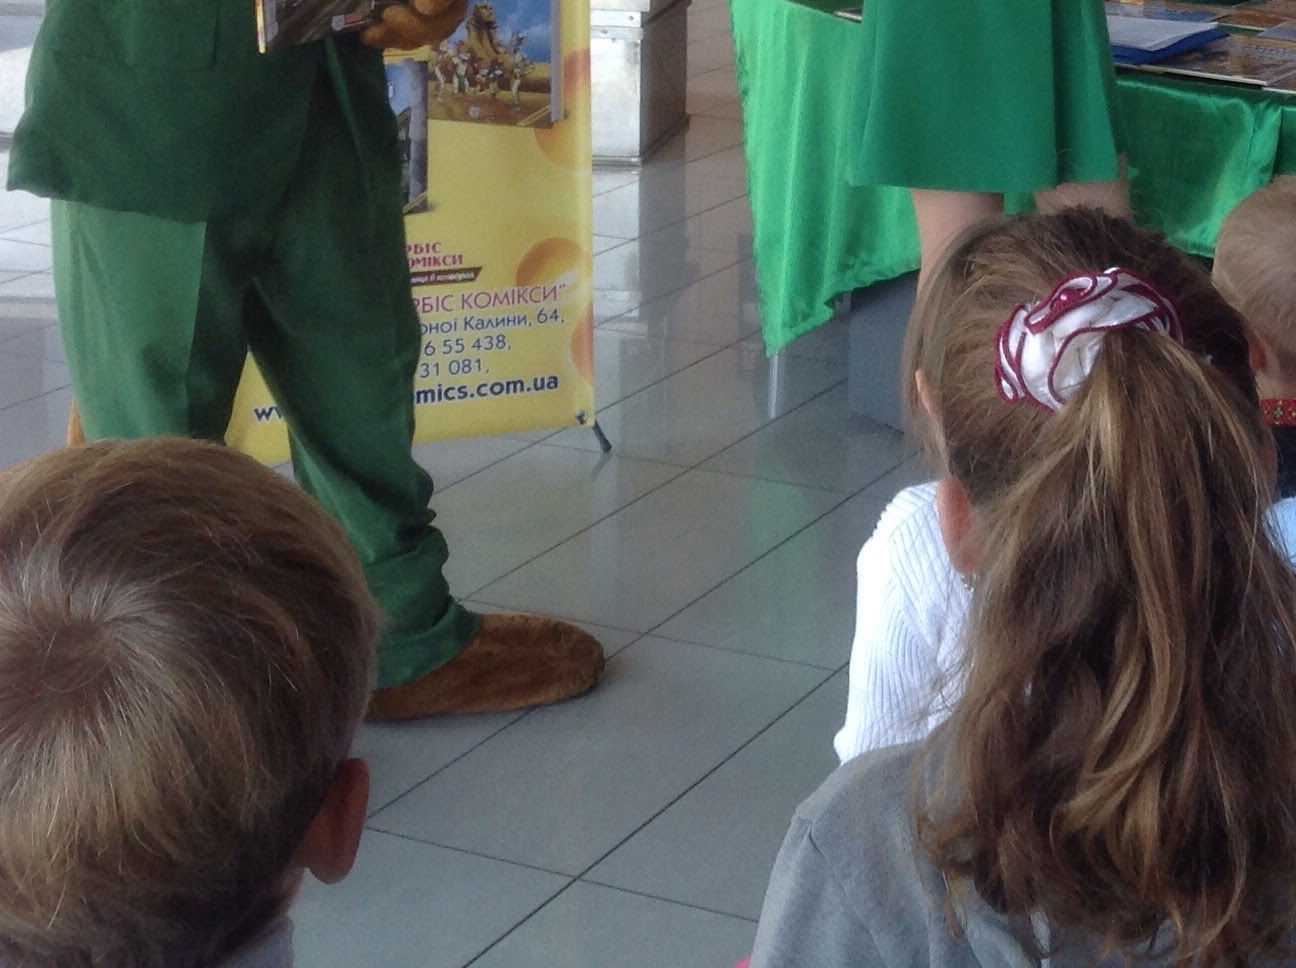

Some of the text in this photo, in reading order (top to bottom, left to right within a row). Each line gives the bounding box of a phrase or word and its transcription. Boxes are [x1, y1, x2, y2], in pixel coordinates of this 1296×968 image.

[463, 315, 532, 332] Калини,
[536, 308, 565, 324] 64,
[442, 338, 466, 355] 55
[471, 335, 512, 352] 438,
[419, 358, 490, 379] 31 081,
